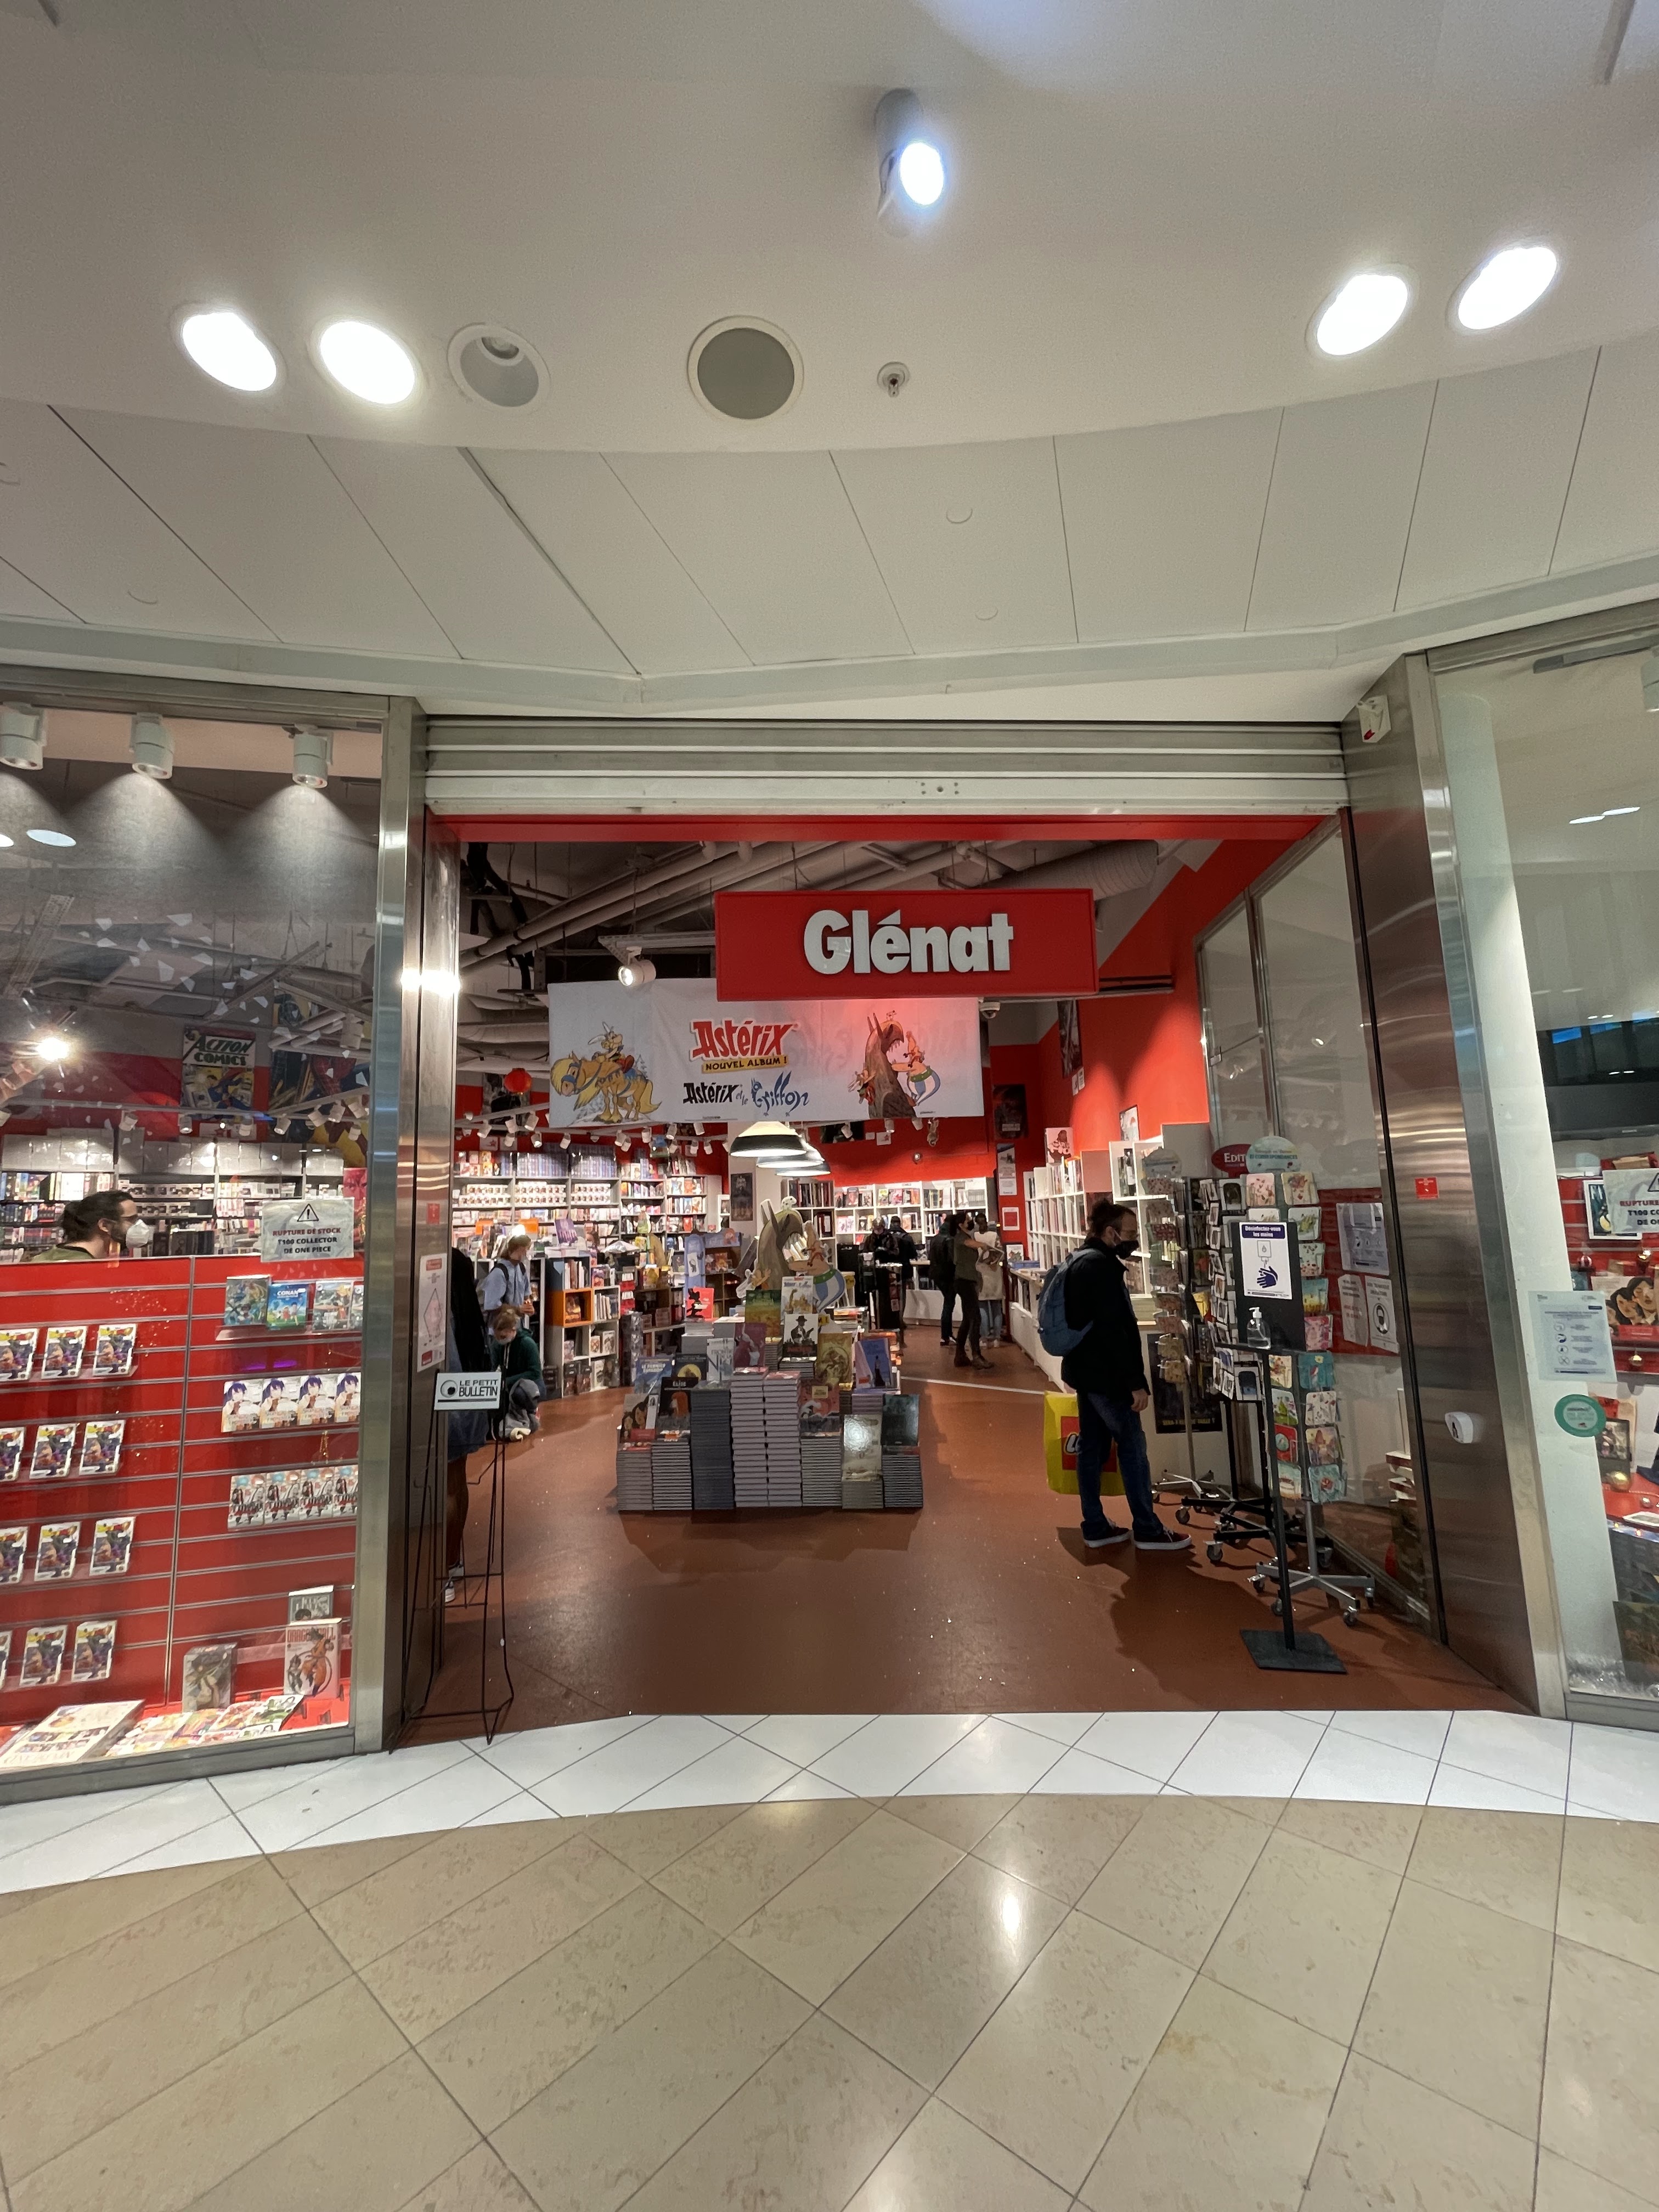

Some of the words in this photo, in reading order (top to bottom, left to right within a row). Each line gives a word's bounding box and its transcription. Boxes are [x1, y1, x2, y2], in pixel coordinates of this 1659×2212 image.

[804, 909, 1014, 974] Glénat
[184, 1035, 255, 1057] ACTION
[692, 1020, 793, 1058] Astérix
[194, 1052, 247, 1066] COMICS
[706, 1060, 744, 1070] NOUVEL
[747, 1057, 780, 1066] ALBUM
[682, 1082, 740, 1104] Astérix
[751, 1071, 810, 1116] Griffon
[459, 1386, 498, 1397] BULLETIN
